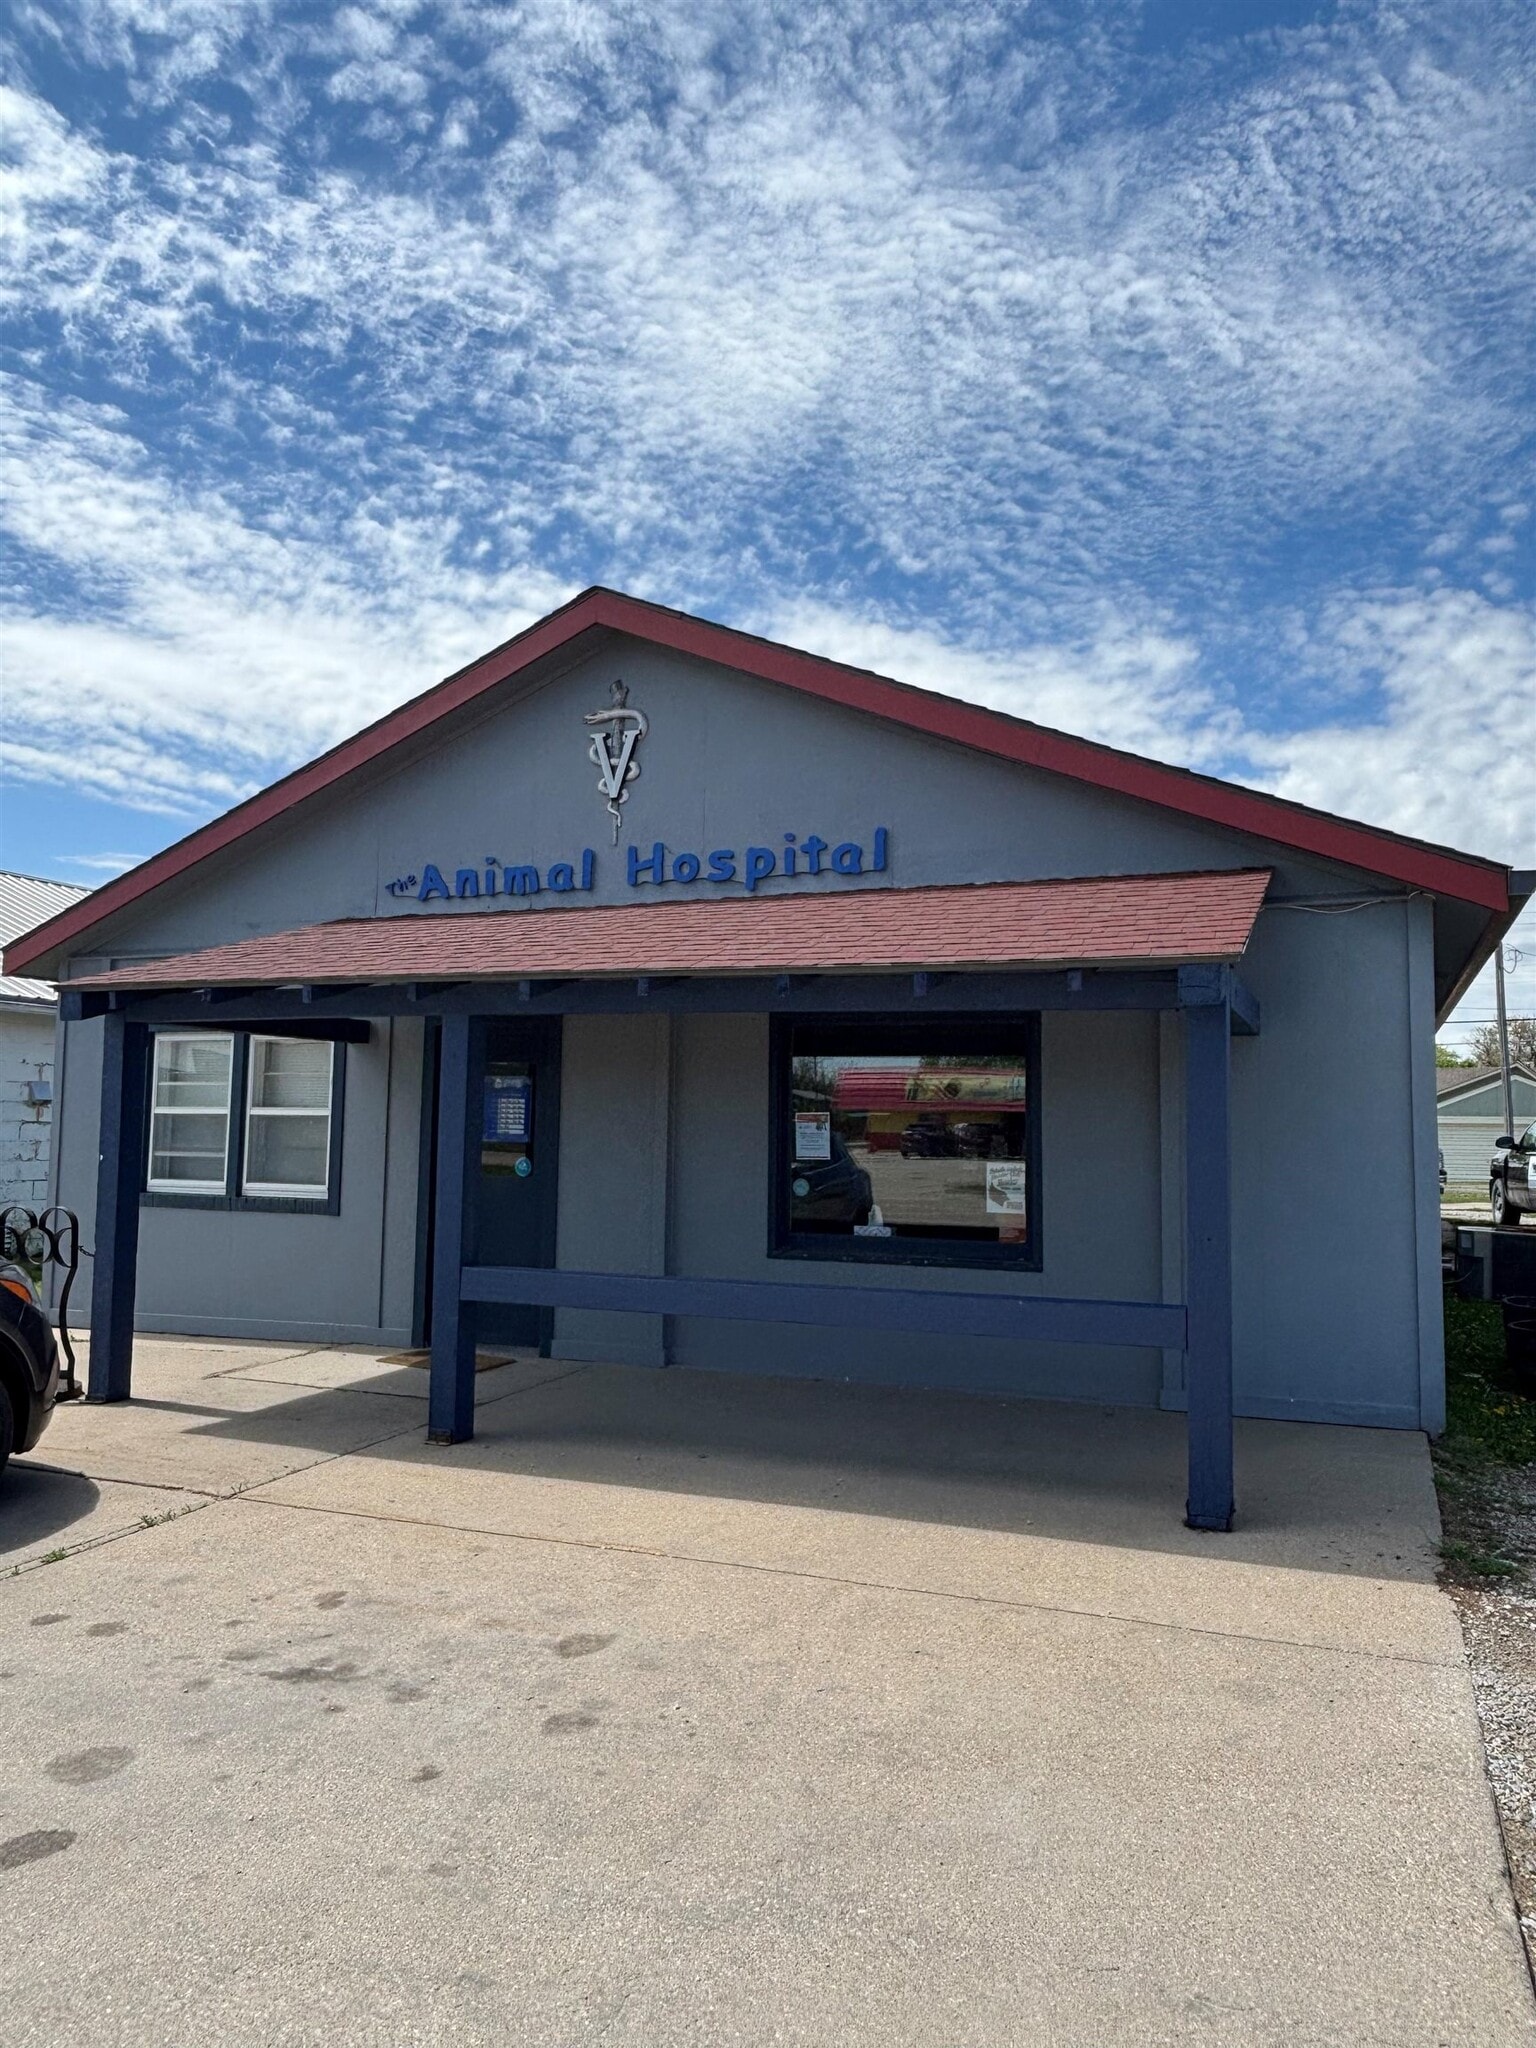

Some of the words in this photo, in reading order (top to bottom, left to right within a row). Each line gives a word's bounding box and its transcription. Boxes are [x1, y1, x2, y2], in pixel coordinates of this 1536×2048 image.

[385, 874, 417, 897] The
[417, 848, 595, 901] Animal
[627, 826, 888, 892] Hospital
